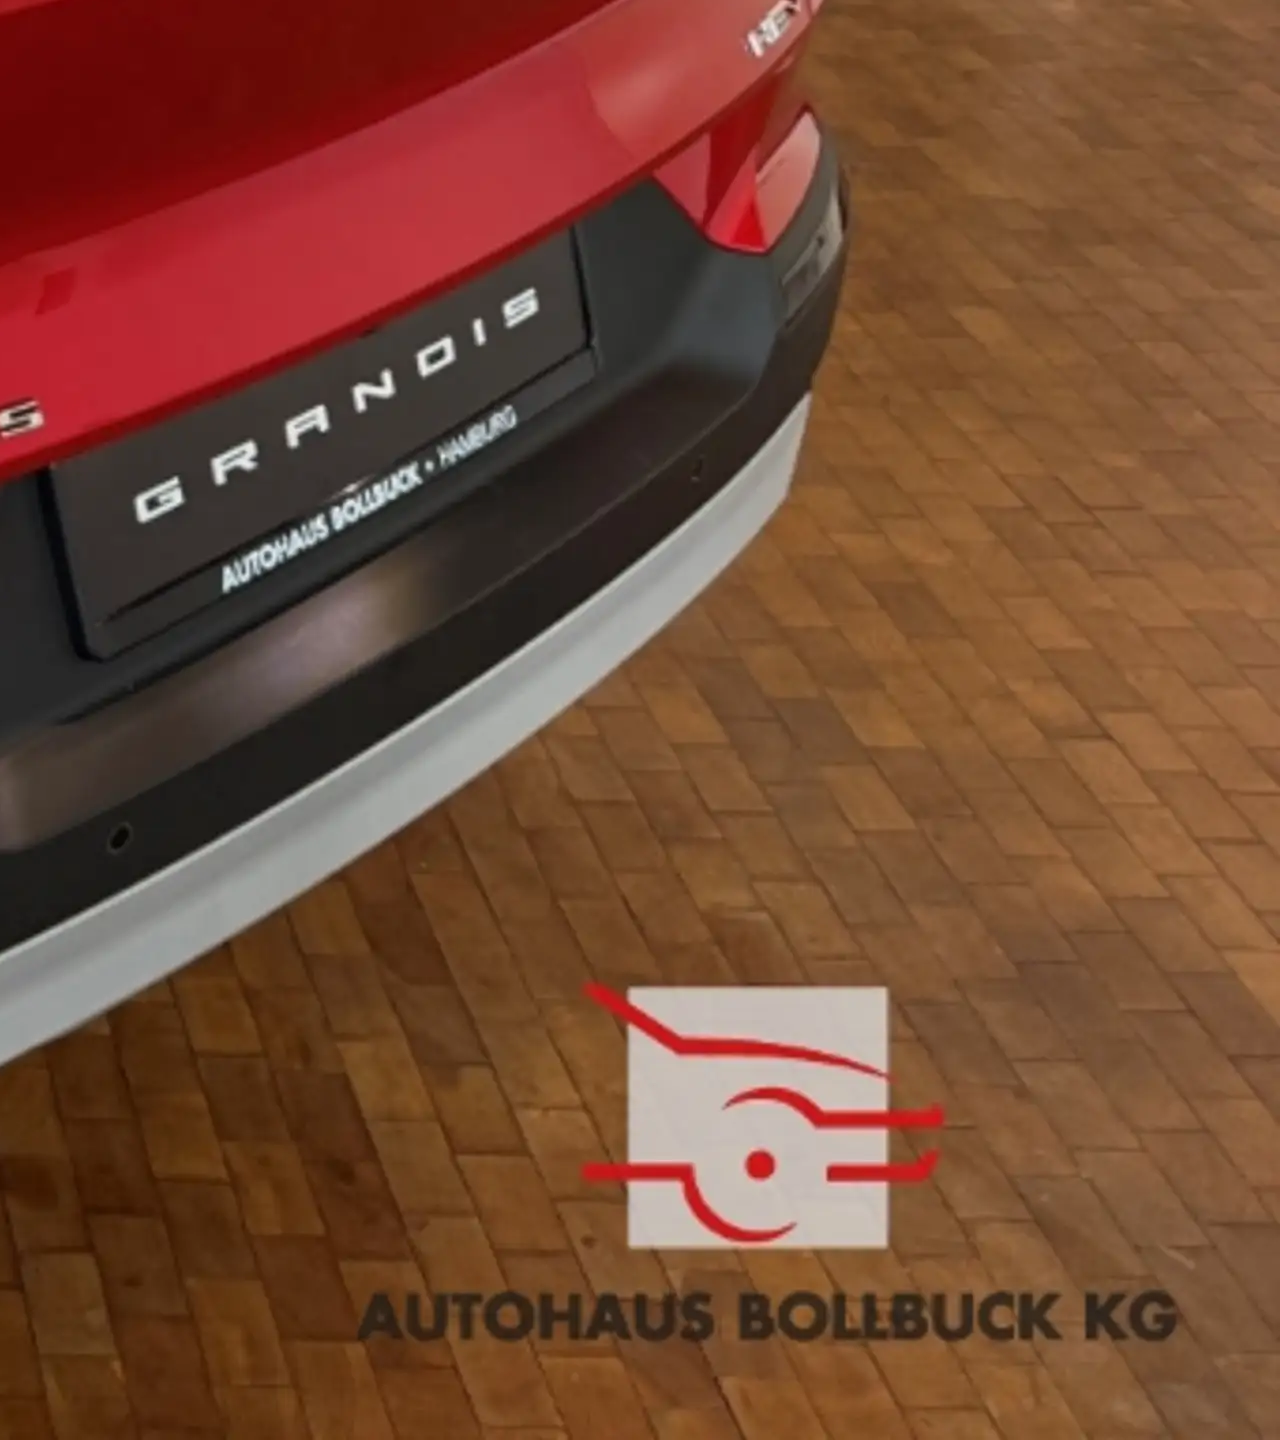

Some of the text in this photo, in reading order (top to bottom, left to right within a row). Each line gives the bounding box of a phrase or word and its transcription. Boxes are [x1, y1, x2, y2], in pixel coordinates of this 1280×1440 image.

[132, 286, 540, 524] GRANDIS
[221, 513, 329, 594] AUTOHAUS
[436, 404, 519, 467] HAMBURG
